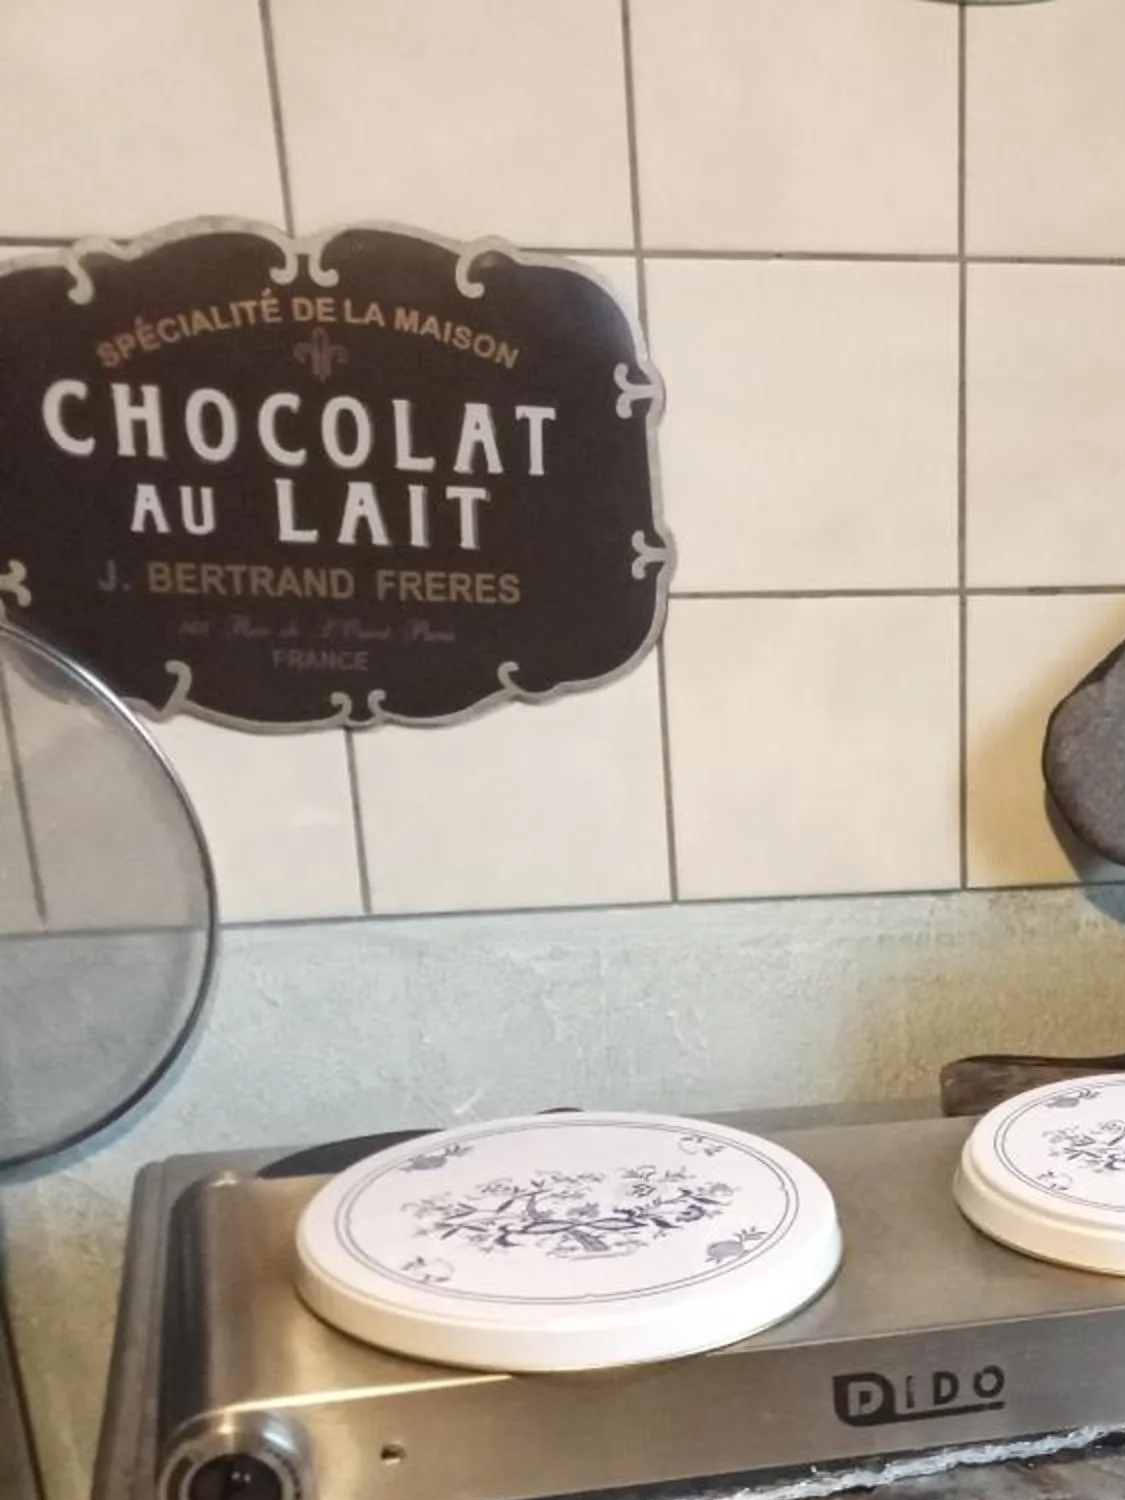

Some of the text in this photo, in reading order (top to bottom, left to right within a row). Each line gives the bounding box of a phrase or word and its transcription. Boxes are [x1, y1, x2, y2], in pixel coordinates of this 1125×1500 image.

[96, 287, 520, 370] SPÉCIALITÉ DE LA MAISON
[42, 379, 557, 477] CHOCOLAT
[130, 478, 492, 550] AU LAIT
[146, 560, 356, 600] BERTRAND
[376, 568, 521, 604] FRERES
[271, 648, 369, 672] FRANCE
[832, 1365, 1006, 1427] DIDO
